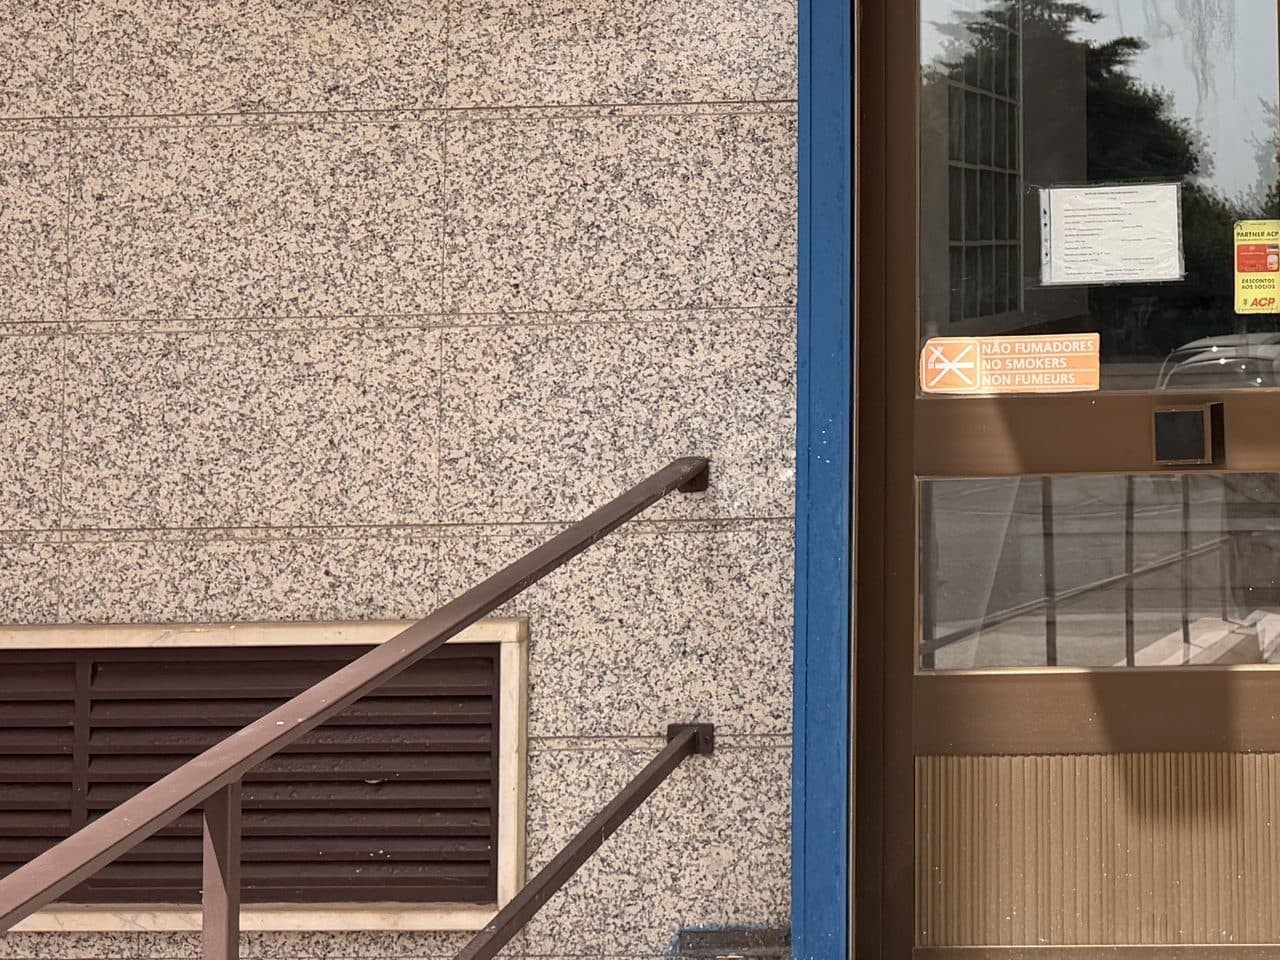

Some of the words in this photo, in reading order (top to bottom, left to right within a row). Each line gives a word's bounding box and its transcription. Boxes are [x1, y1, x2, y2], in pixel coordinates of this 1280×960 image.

[1250, 297, 1276, 307] ACP
[982, 340, 1011, 354] NÃO
[1015, 340, 1095, 353] FUMADORES
[982, 358, 1003, 370] NO
[1006, 357, 1067, 369] SMOKERS
[982, 374, 1012, 385] NON
[1015, 373, 1075, 384] FUMEURS
